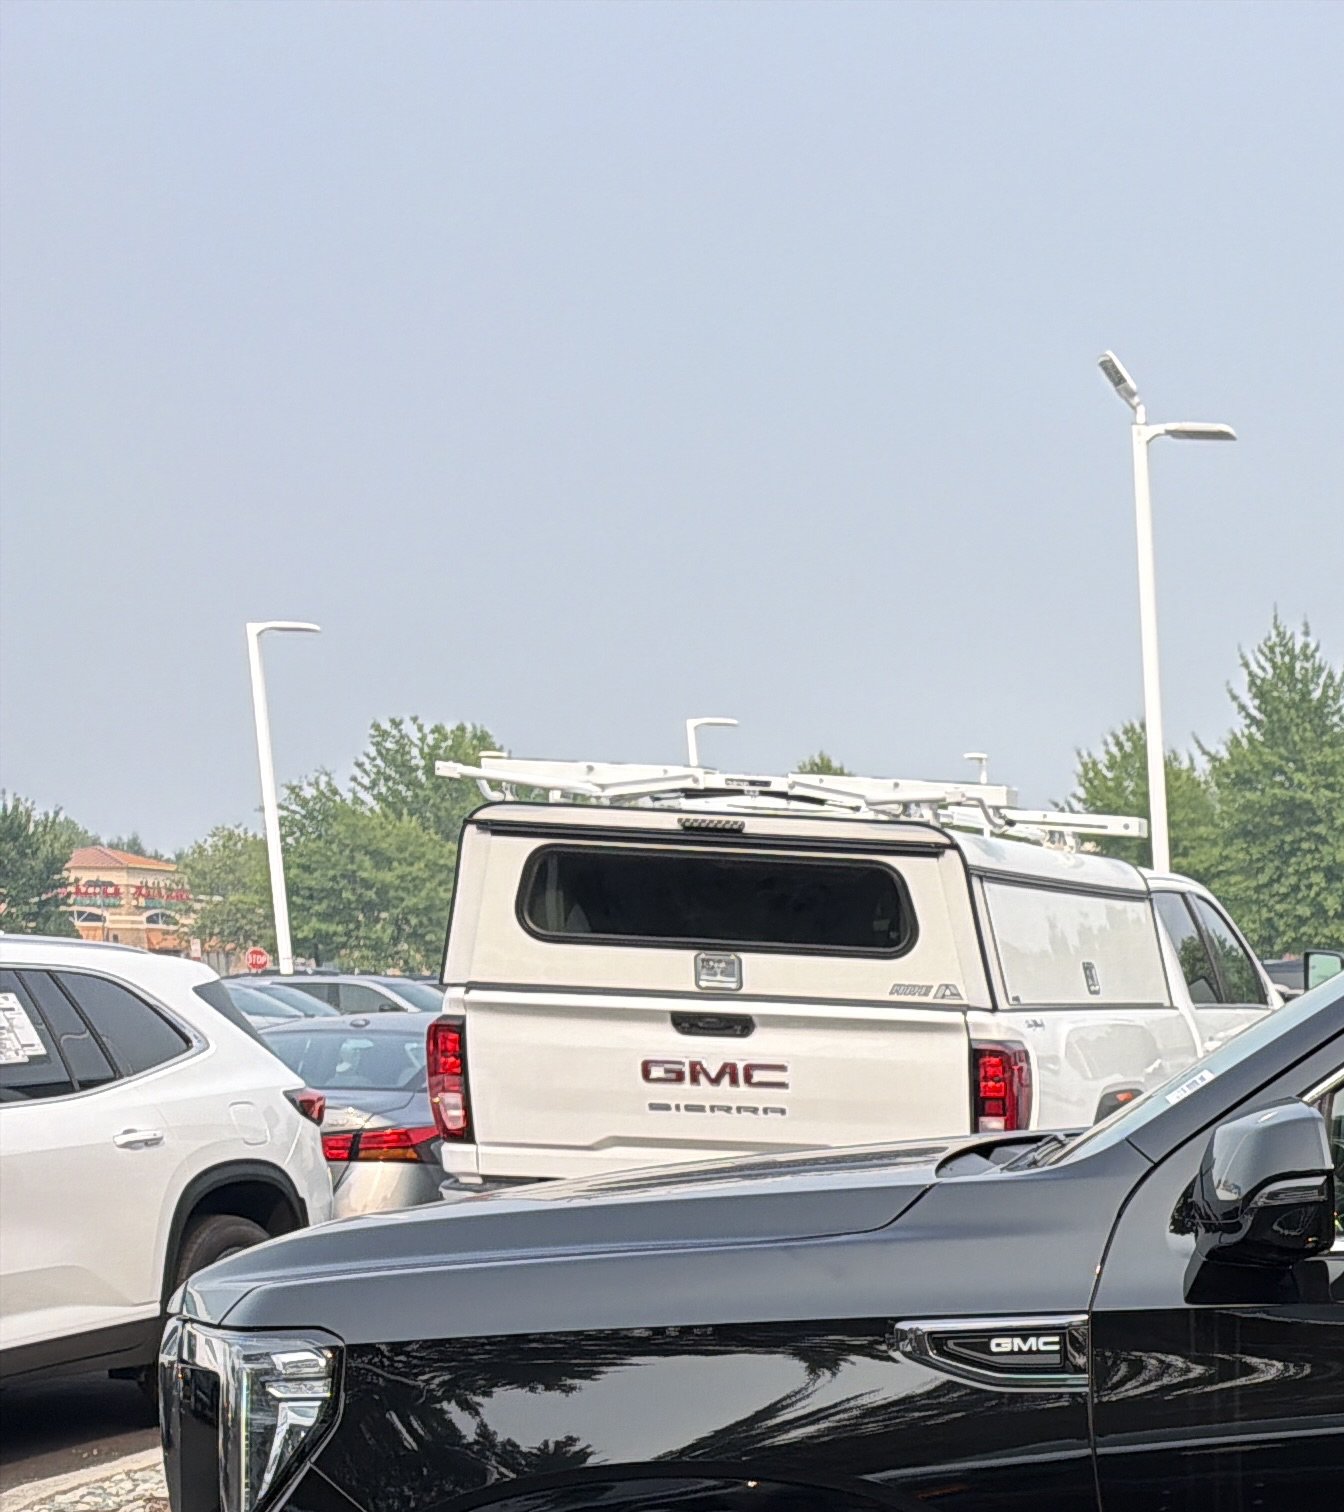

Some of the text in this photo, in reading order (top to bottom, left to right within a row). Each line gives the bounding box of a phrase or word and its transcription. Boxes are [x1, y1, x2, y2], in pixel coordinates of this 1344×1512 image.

[247, 953, 267, 965] STOP
[641, 1059, 789, 1090] GMC
[648, 1102, 787, 1116] SIERRA
[989, 1336, 1061, 1353] GMC
